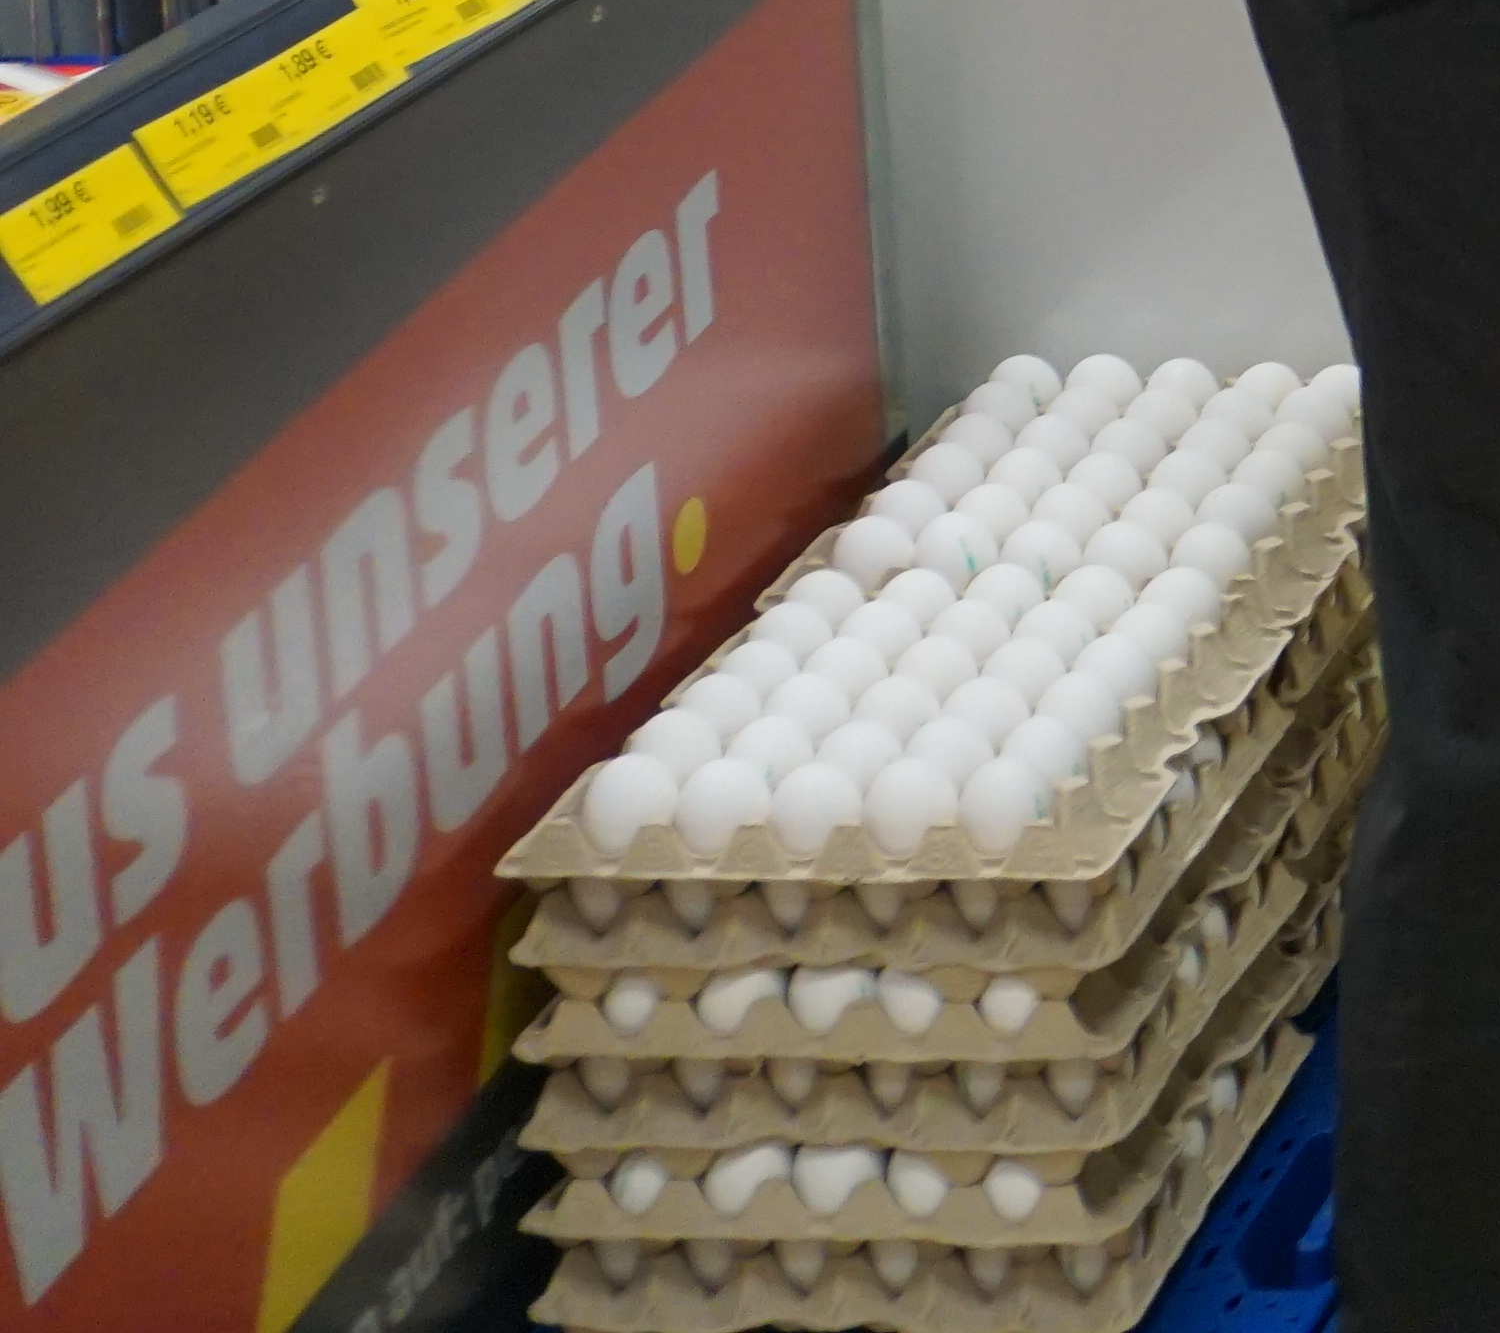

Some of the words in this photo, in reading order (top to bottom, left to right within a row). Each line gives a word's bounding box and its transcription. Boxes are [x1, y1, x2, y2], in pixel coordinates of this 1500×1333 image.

[29, 191, 75, 230] 1,99
[173, 103, 213, 140] 1,19
[219, 169, 719, 788] unserer
[0, 461, 706, 1306] Werbung.
